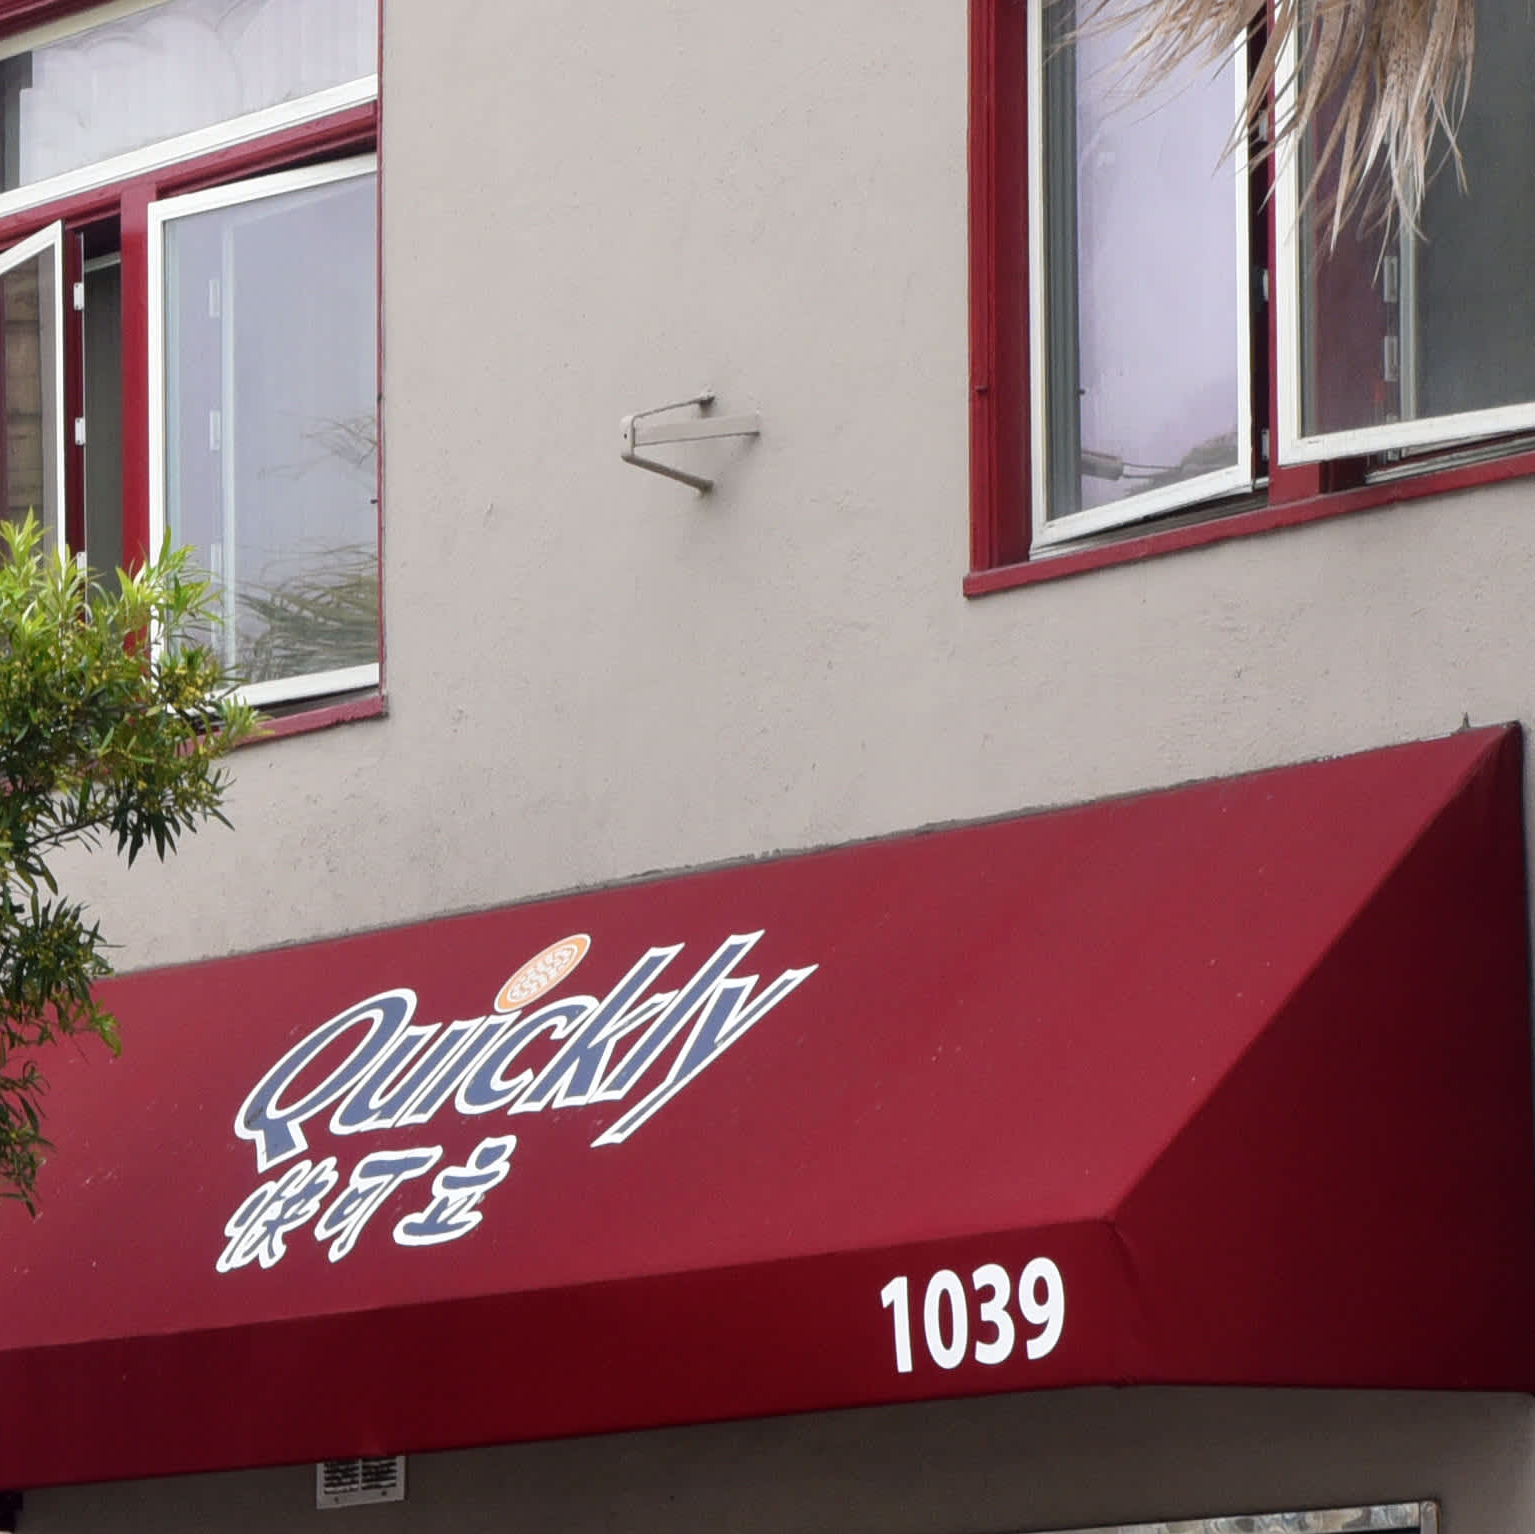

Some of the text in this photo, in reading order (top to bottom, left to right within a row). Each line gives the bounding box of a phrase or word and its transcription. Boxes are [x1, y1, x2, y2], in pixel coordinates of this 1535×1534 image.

[233, 930, 820, 1173] Quickly
[215, 1135, 518, 1273] 快可立
[880, 1256, 1066, 1373] 1039
